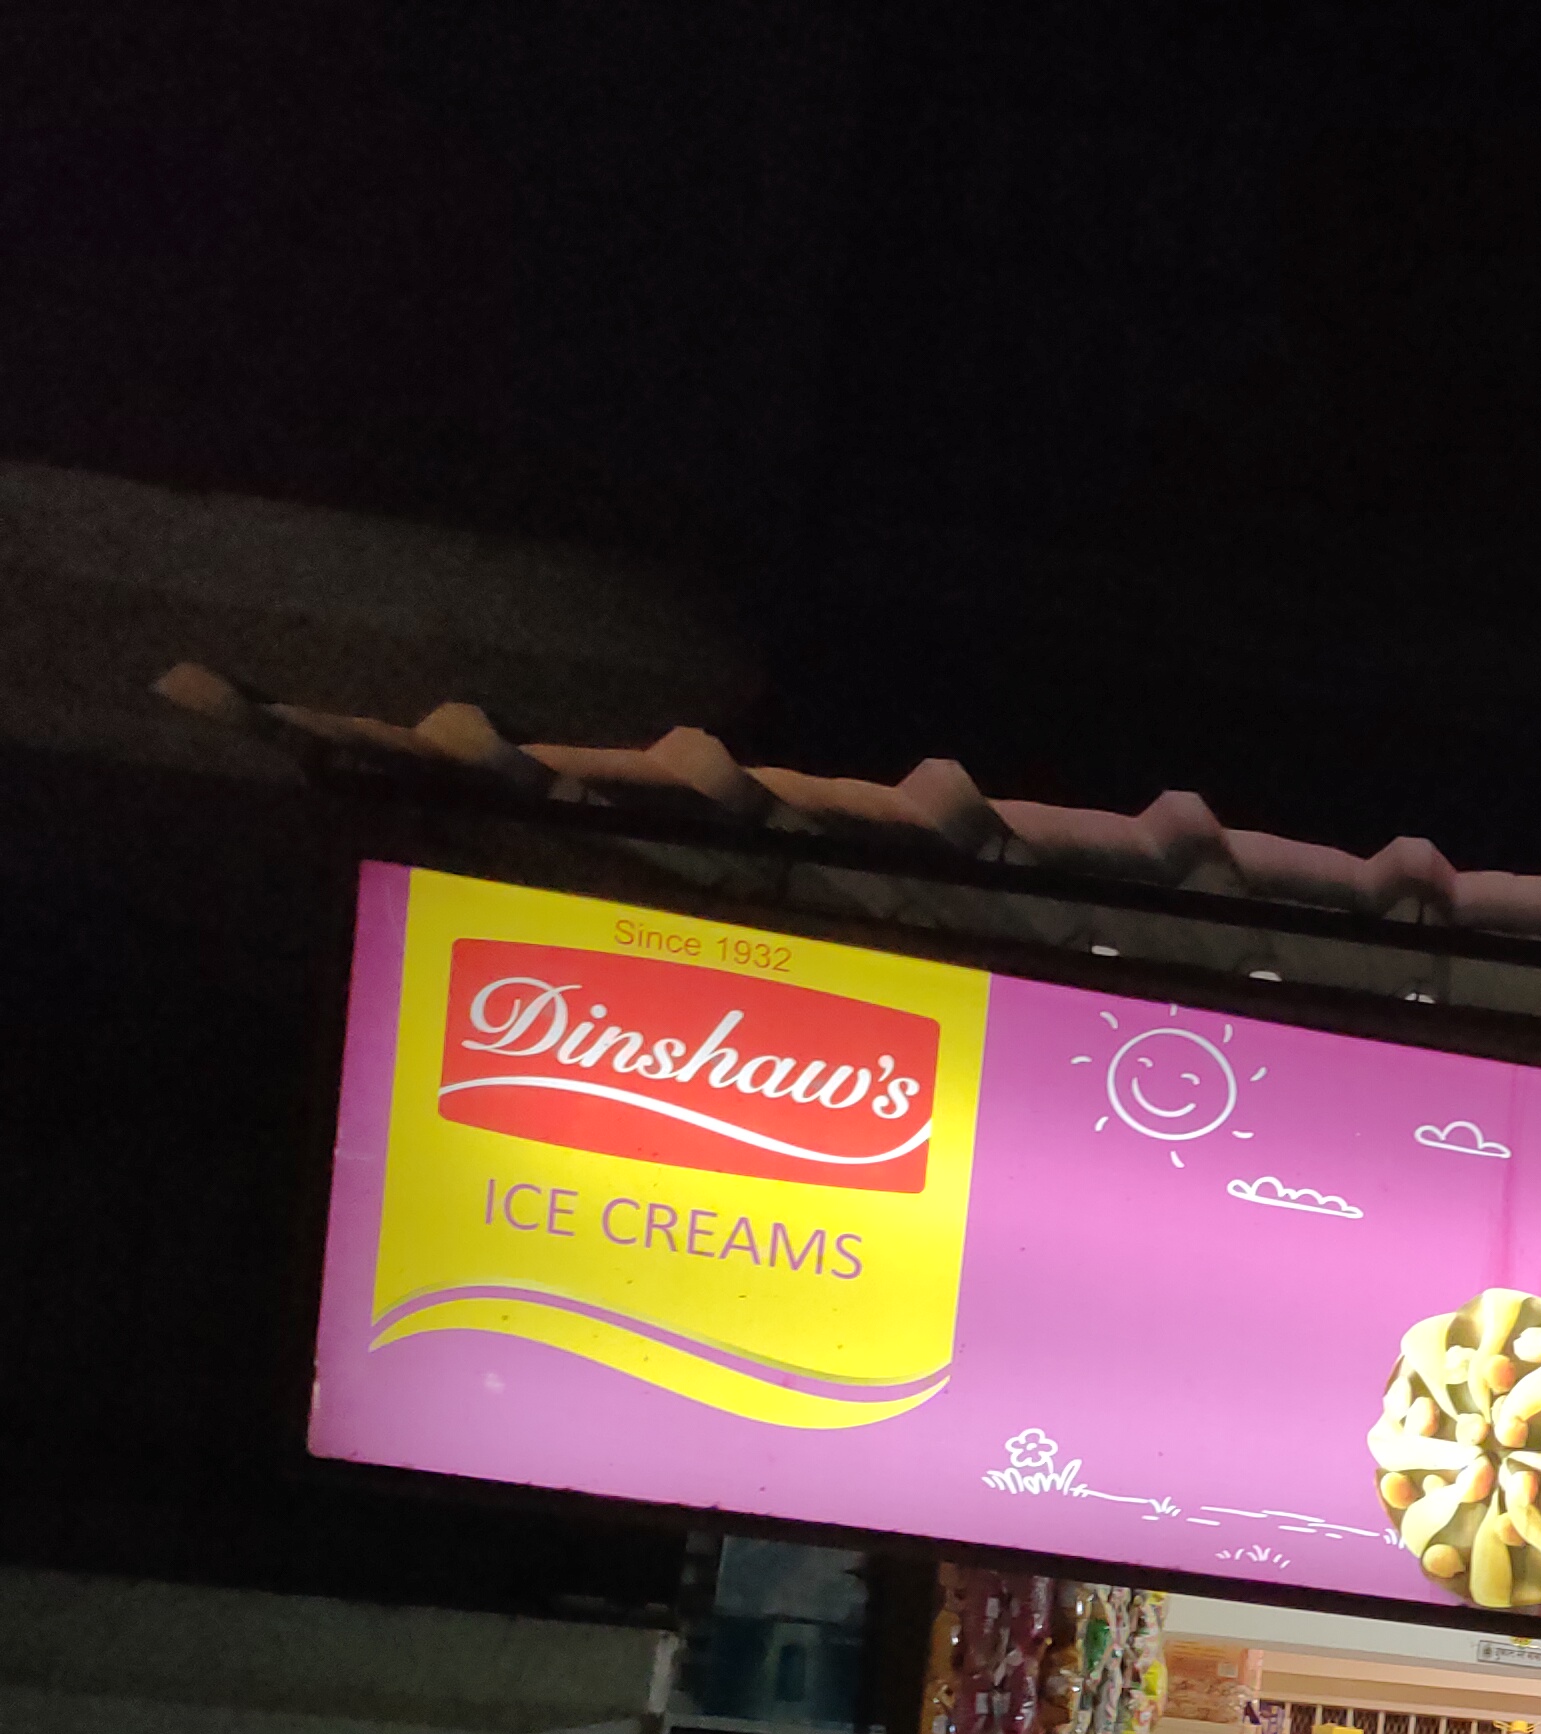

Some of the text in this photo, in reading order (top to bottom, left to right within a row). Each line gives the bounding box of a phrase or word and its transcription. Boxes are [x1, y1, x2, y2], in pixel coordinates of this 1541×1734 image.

[614, 919, 792, 973] Since 1932
[462, 977, 920, 1120] Dinshaw's
[484, 1178, 864, 1280] ICE CREAMS
